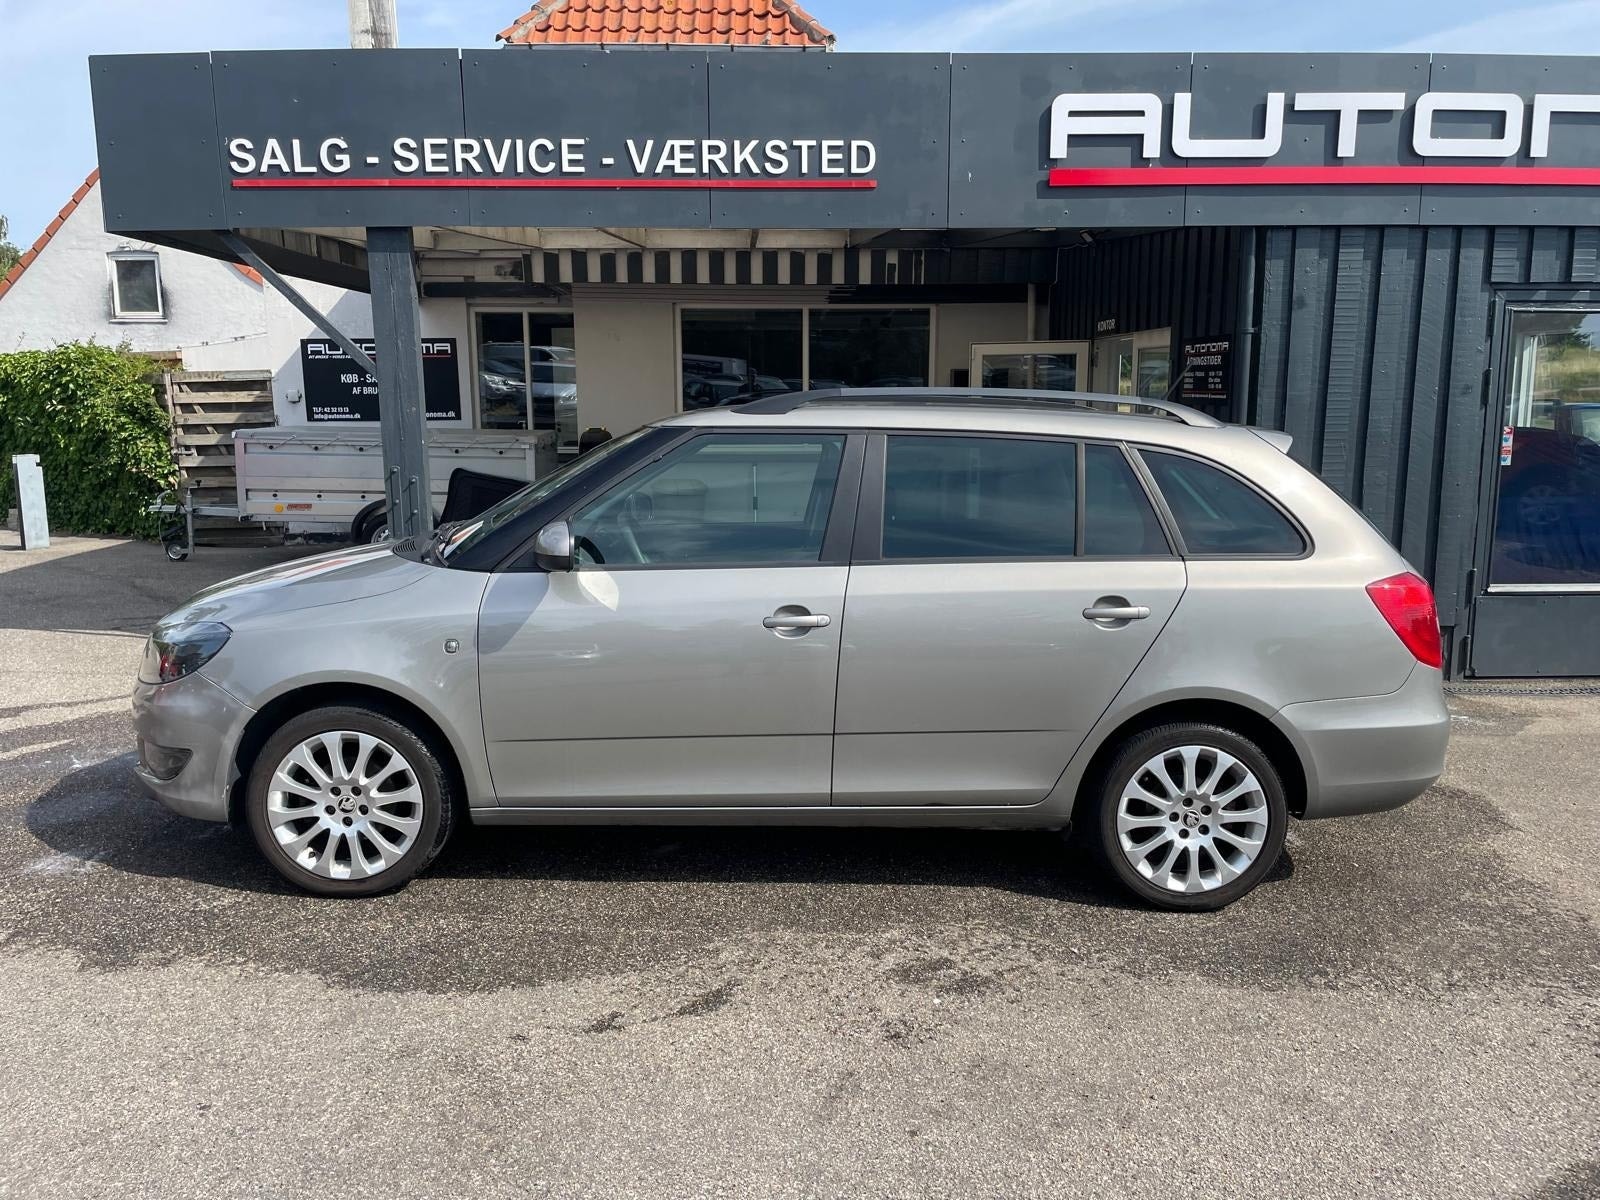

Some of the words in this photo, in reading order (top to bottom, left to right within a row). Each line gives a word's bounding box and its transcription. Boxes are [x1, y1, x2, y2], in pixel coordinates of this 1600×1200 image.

[229, 138, 351, 173] SALG
[393, 138, 585, 173] SERVICE
[626, 139, 876, 174] VÆRKSTED
[1185, 341, 1229, 353] AUTONOMA
[1186, 355, 1222, 366] ÅNGSTIDER
[340, 373, 358, 383] KØB
[352, 386, 361, 395] AF
[363, 386, 378, 395] BRU
